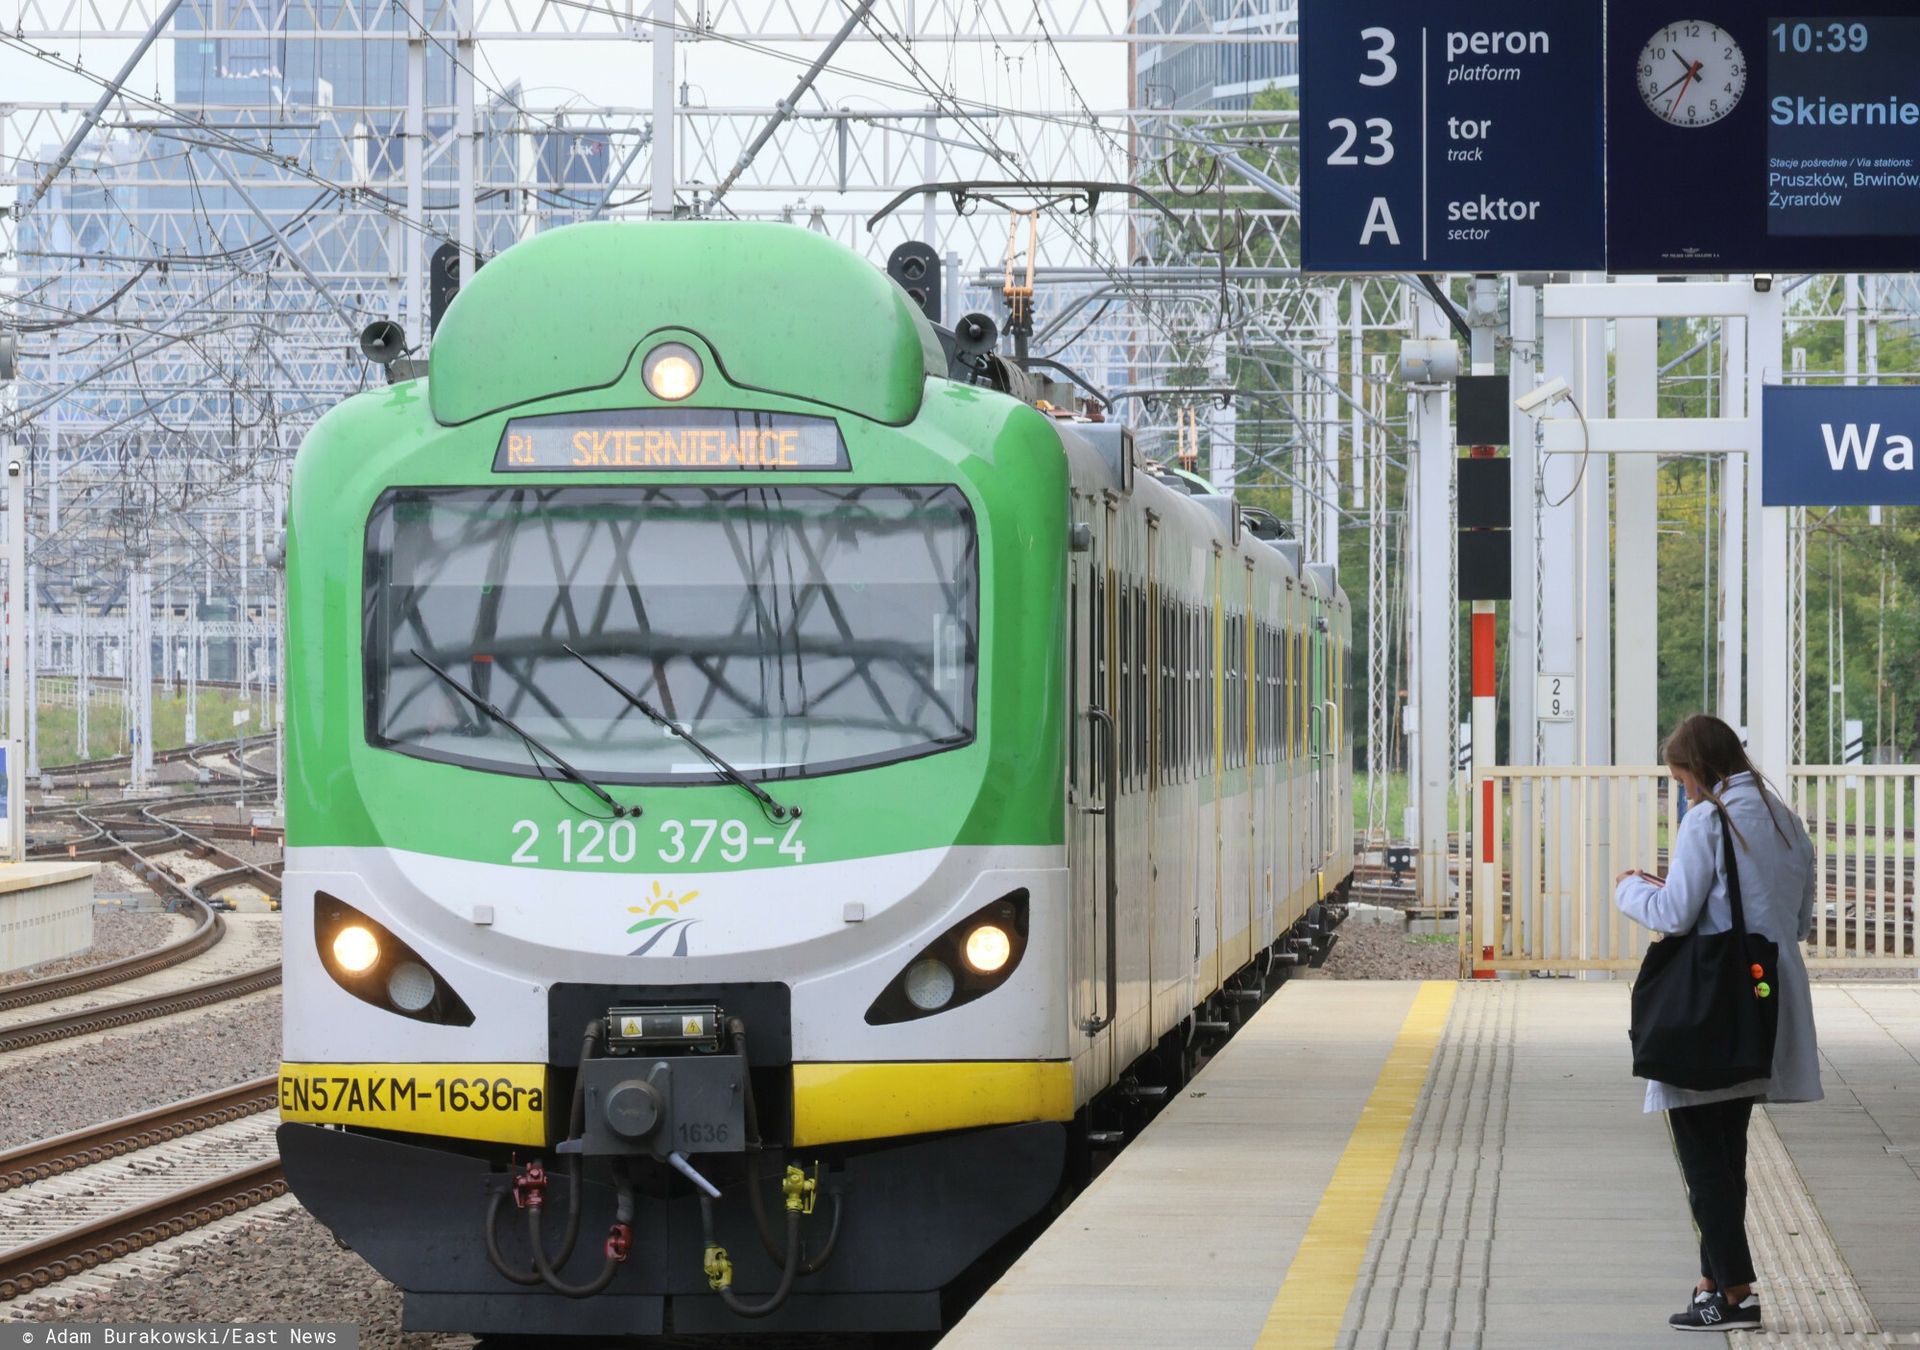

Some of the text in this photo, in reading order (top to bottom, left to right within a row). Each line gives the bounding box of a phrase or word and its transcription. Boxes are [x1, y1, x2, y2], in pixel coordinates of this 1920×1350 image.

[1664, 31, 1677, 42] 11
[1684, 25, 1700, 37] 12
[1711, 31, 1717, 42] 1
[1771, 23, 1868, 52] 10:39
[1447, 29, 1549, 62] peron
[1649, 48, 1666, 60] 10
[1724, 48, 1733, 60] 2
[1358, 26, 1398, 87] 3
[1447, 64, 1520, 84] platform
[1643, 65, 1652, 77] 9
[1731, 64, 1739, 77] 3
[1649, 82, 1658, 94] 8
[1724, 82, 1732, 93] 4
[1665, 100, 1673, 111] 7
[1687, 105, 1696, 118] 6
[1709, 99, 1718, 111] 5
[1770, 96, 1920, 126] Skiernie
[1448, 116, 1491, 139] tor
[1326, 117, 1395, 166] 23
[1448, 147, 1483, 161] track
[1769, 158, 1799, 169] Stacje
[1801, 158, 1848, 168] pośrednie
[1857, 157, 1871, 167] Via
[1873, 158, 1914, 167] stations:
[1769, 172, 1848, 189] Pruszków,
[1448, 194, 1540, 220] sektor
[1769, 189, 1842, 209] Żyrardów
[1359, 197, 1400, 245] A
[1448, 228, 1490, 240] sector
[508, 430, 800, 466] R1 SKIERNIEWICE
[1821, 423, 1914, 471] Wa
[1552, 678, 1561, 695] 2
[1552, 698, 1560, 716] 9
[511, 819, 806, 863] 2 120 379-4
[280, 1077, 543, 1113] EN57AKM-1636ra
[678, 1122, 728, 1144] 1636
[1700, 1305, 1722, 1324] N
